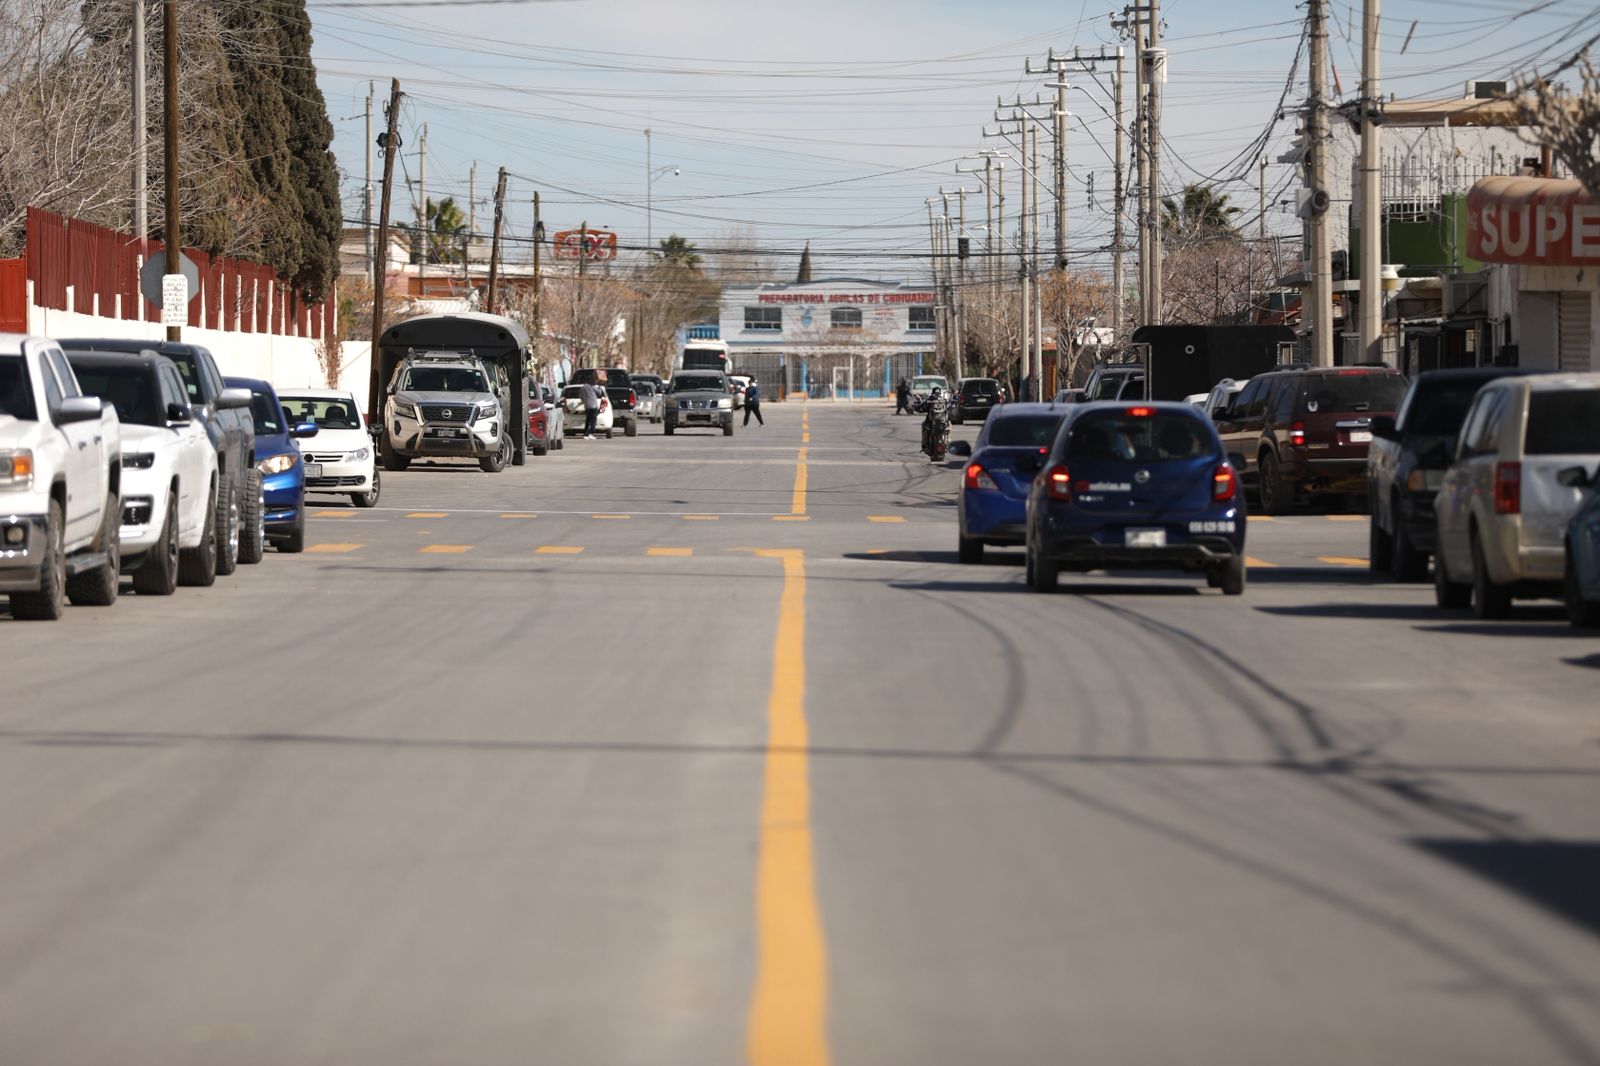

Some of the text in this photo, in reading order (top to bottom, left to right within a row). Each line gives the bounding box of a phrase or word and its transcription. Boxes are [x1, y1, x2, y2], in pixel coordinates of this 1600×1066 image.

[1481, 203, 1600, 257] SUPE
[758, 294, 824, 304] PREPARATORIA
[868, 293, 880, 304] DE
